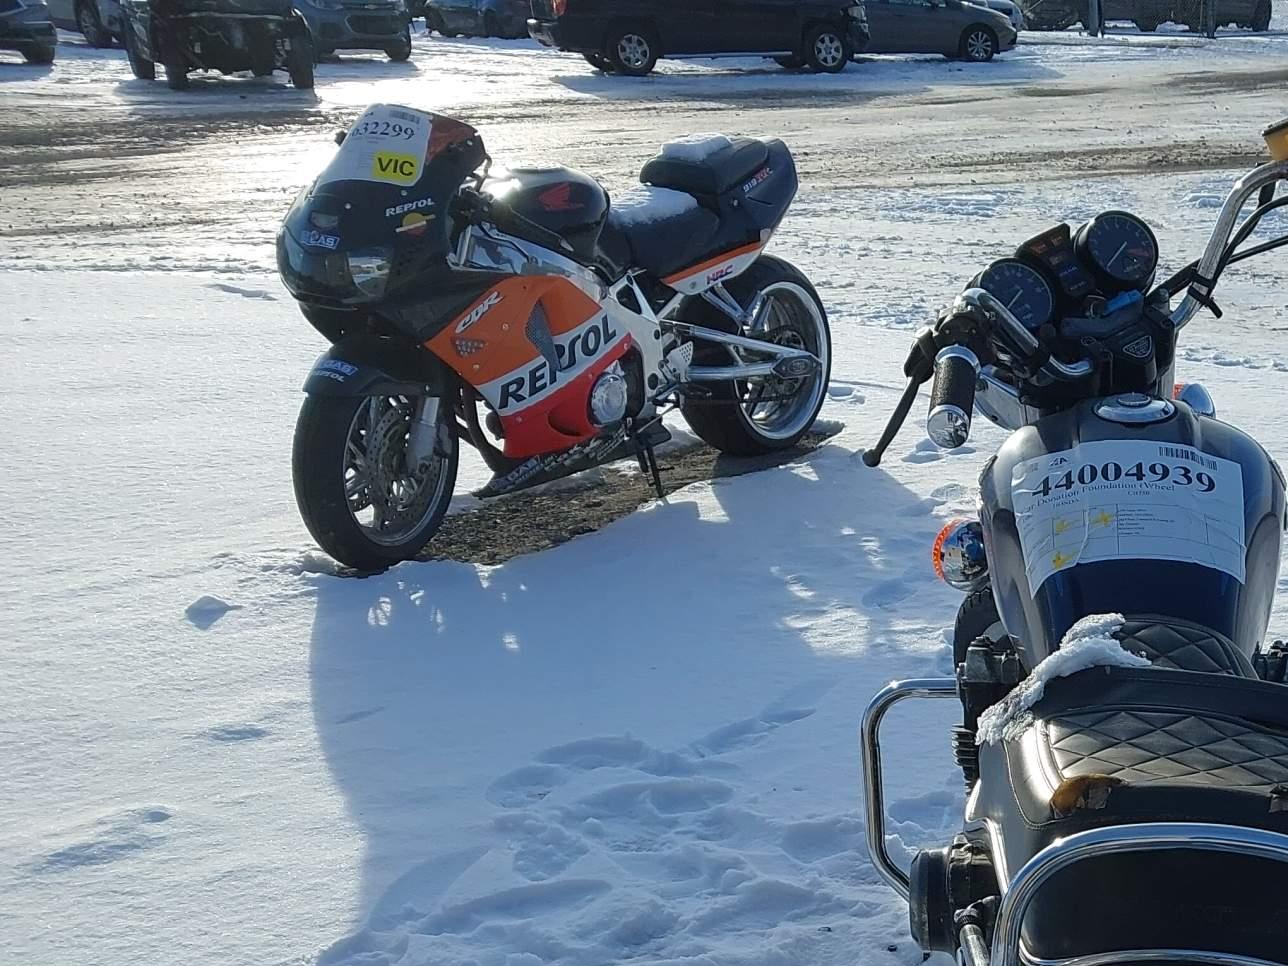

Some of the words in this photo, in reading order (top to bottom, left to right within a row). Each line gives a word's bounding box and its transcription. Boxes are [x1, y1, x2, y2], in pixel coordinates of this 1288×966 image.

[378, 158, 415, 177] VIC
[385, 197, 435, 217] REPSOL
[498, 313, 617, 410] REPSOL
[1032, 461, 1216, 497] 44004939
[1037, 491, 1079, 506] Donation
[1082, 482, 1137, 493] Foundation
